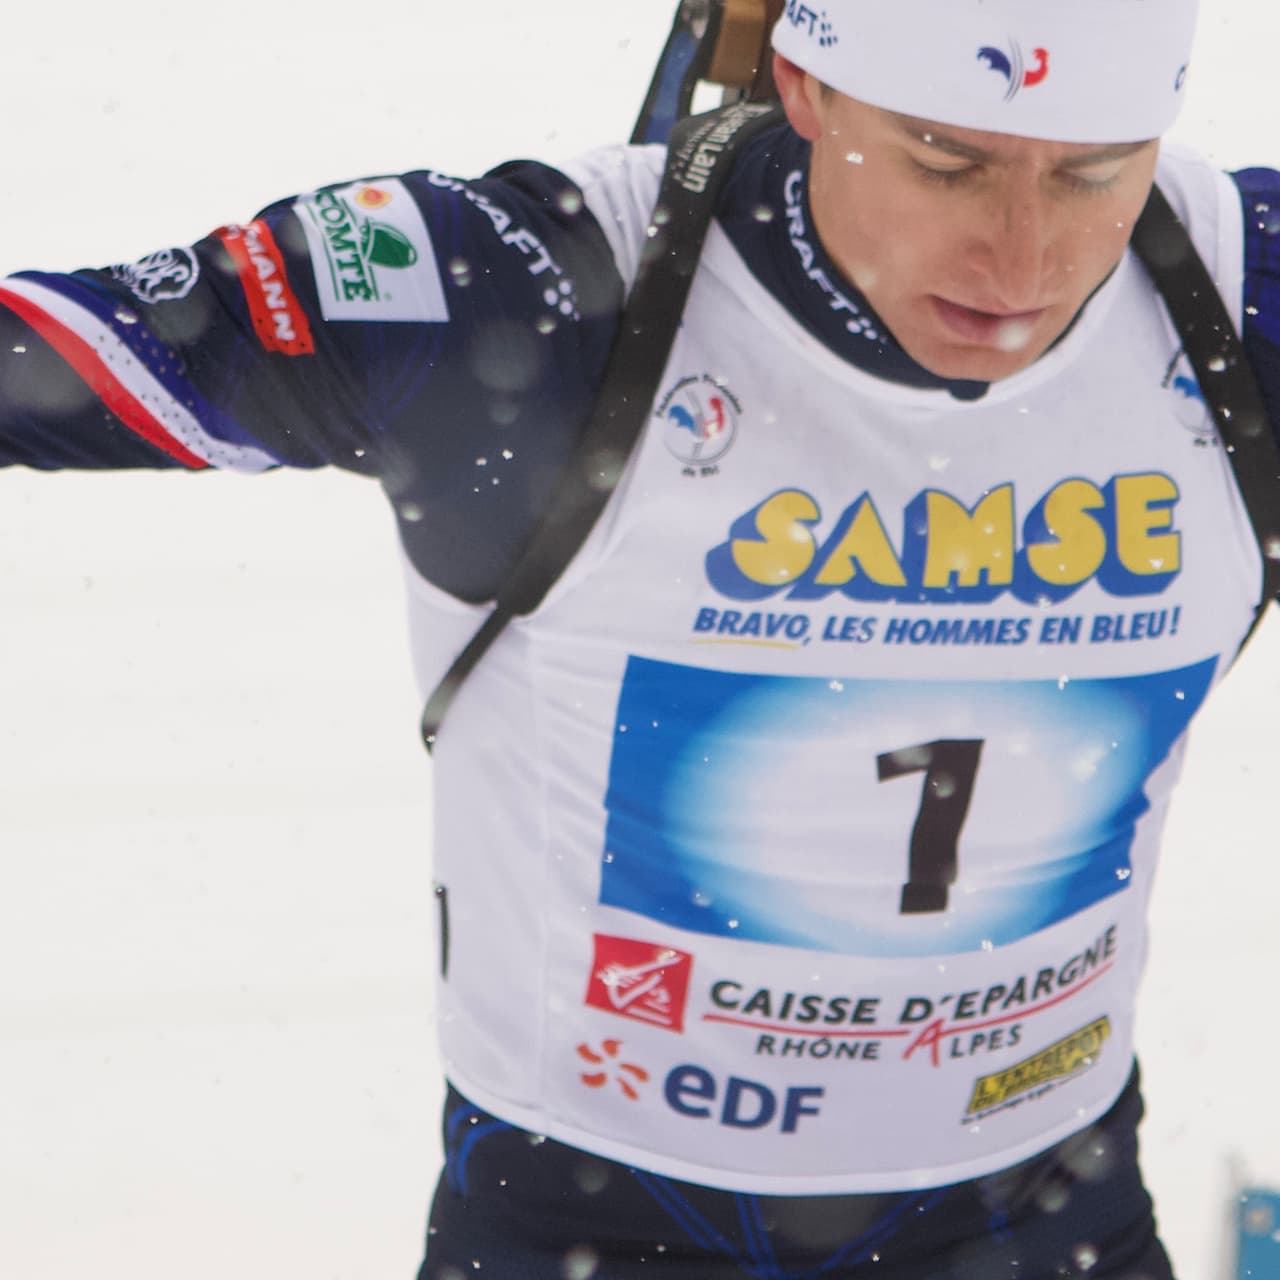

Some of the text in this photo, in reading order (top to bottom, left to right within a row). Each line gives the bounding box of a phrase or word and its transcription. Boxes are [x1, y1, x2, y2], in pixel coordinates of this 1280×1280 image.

[784, 170, 860, 315] CRAFT
[705, 471, 1182, 607] SAMSE
[692, 607, 812, 647] BRAVO,
[822, 616, 878, 643] LES
[883, 617, 1031, 646] HOMMES
[1038, 616, 1082, 645] EN
[876, 738, 985, 914] 1
[709, 980, 881, 1025] CAISSE
[902, 1017, 1022, 1068] ALPES
